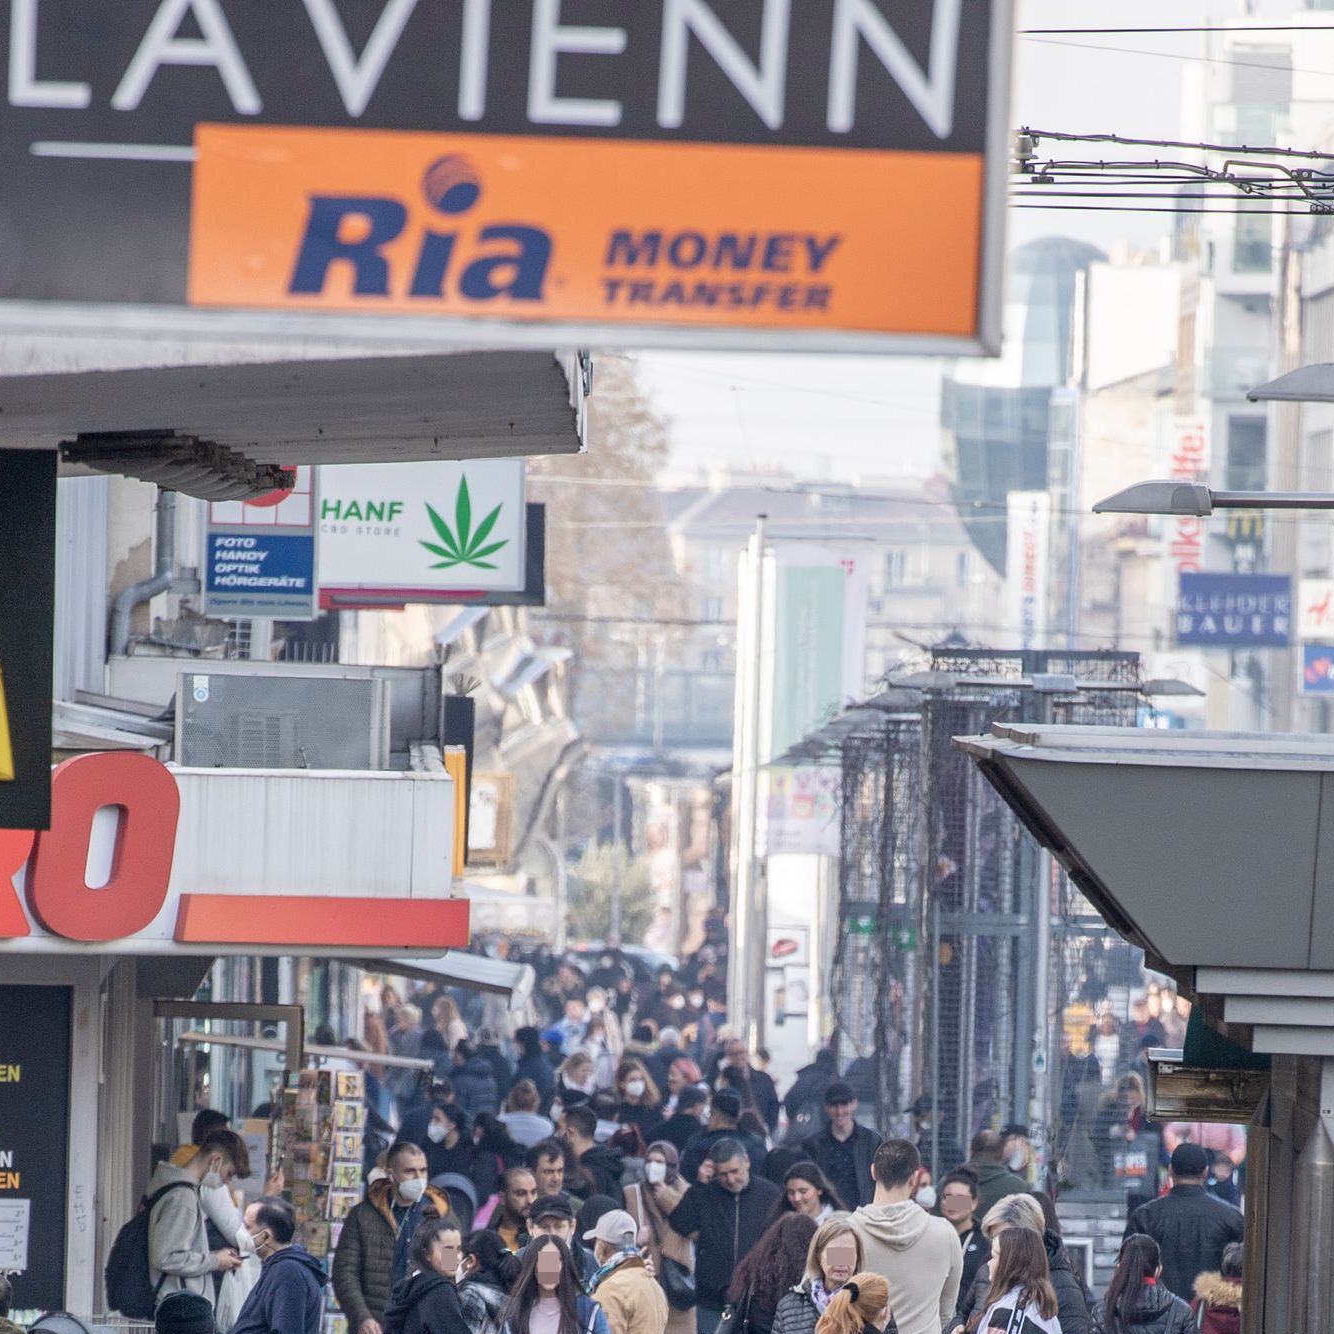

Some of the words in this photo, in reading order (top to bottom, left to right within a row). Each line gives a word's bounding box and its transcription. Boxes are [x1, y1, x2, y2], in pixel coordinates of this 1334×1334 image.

[8, 0, 962, 138] LAVIENN
[287, 153, 554, 302] Ria
[604, 228, 842, 273] MONEY
[600, 278, 832, 312] TRANSFER
[320, 498, 404, 522] HANF
[214, 537, 258, 549] FOTO
[214, 550, 268, 562] HANDY
[214, 562, 262, 575] OPTIK
[214, 574, 307, 589] HÖRGERÄTE
[1178, 593, 1290, 616] KLEIDER
[1176, 614, 1290, 636] BAUER
